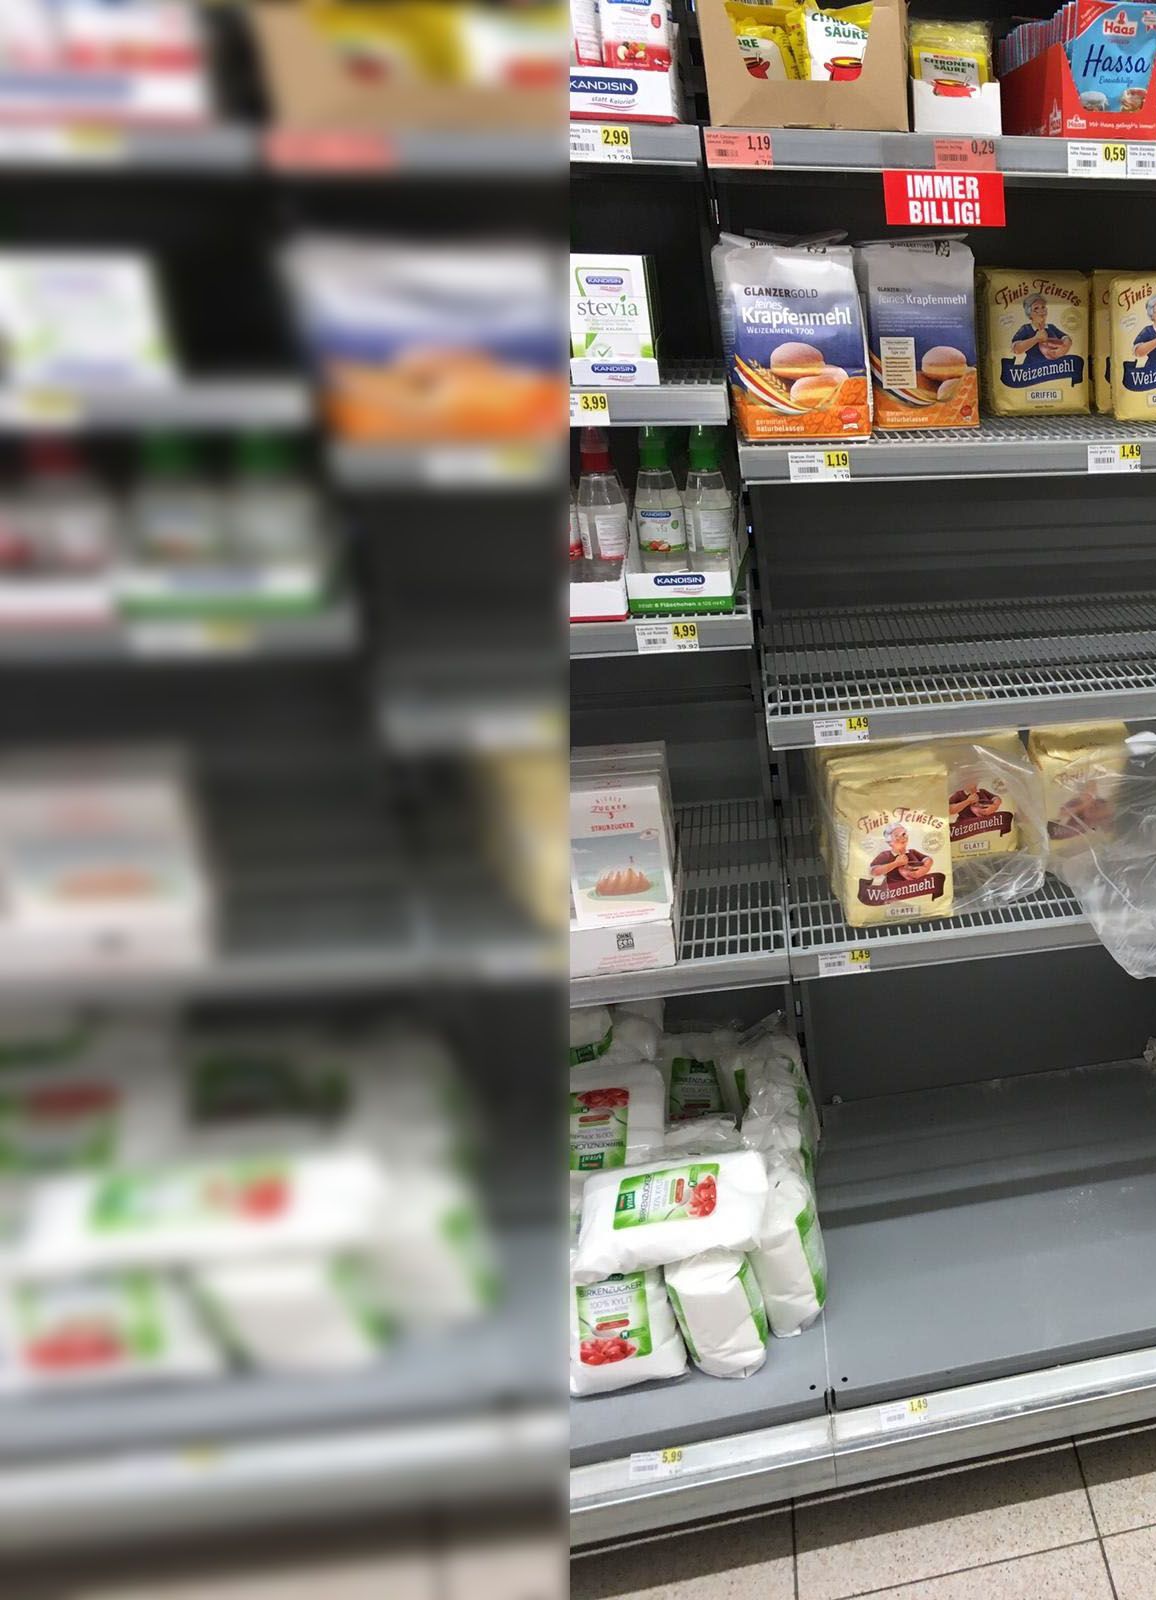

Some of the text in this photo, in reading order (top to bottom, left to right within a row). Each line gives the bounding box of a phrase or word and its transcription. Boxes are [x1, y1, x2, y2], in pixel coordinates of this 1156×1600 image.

[1104, 21, 1136, 35] Haas
[923, 57, 975, 69] CITRONEN
[1082, 44, 1151, 77] Hassa
[934, 63, 967, 74] SÄURE
[570, 80, 633, 92] KANDISIN
[603, 129, 629, 146] 2,99
[747, 135, 771, 151] 1,19
[971, 139, 995, 155] 0,29
[1104, 146, 1126, 162] 0,59
[906, 175, 980, 199] IMMER
[908, 202, 981, 225] BILLIG!
[744, 286, 818, 299] GLANZERGOLD
[906, 293, 968, 307] Krapfenmehl
[995, 278, 1082, 310] Fini's Feinstes
[1117, 282, 1153, 311] Fini's
[577, 297, 638, 317] stevia
[742, 306, 852, 329] Krapfenmehl
[796, 327, 815, 336] T700
[593, 365, 635, 373] KANDISIN
[1009, 360, 1075, 383] Weizenmehl
[582, 395, 607, 410] 3,99
[1030, 390, 1058, 400] GRIFFIG
[756, 425, 805, 433] naturbelassen
[1121, 444, 1141, 459] 1,49
[827, 452, 848, 468] 1,19
[656, 576, 702, 585] KANDISIN
[673, 624, 696, 639] 4,99
[848, 716, 869, 731] 1,49
[857, 806, 944, 836] Fini's Feinstes
[963, 842, 985, 851] GLATT
[867, 876, 936, 902] Weizenmehl
[851, 949, 870, 961] 1,49
[578, 1280, 642, 1298] BIRKENZUCKER
[909, 1397, 928, 1412] 1,49
[662, 1450, 683, 1464] 5,99
